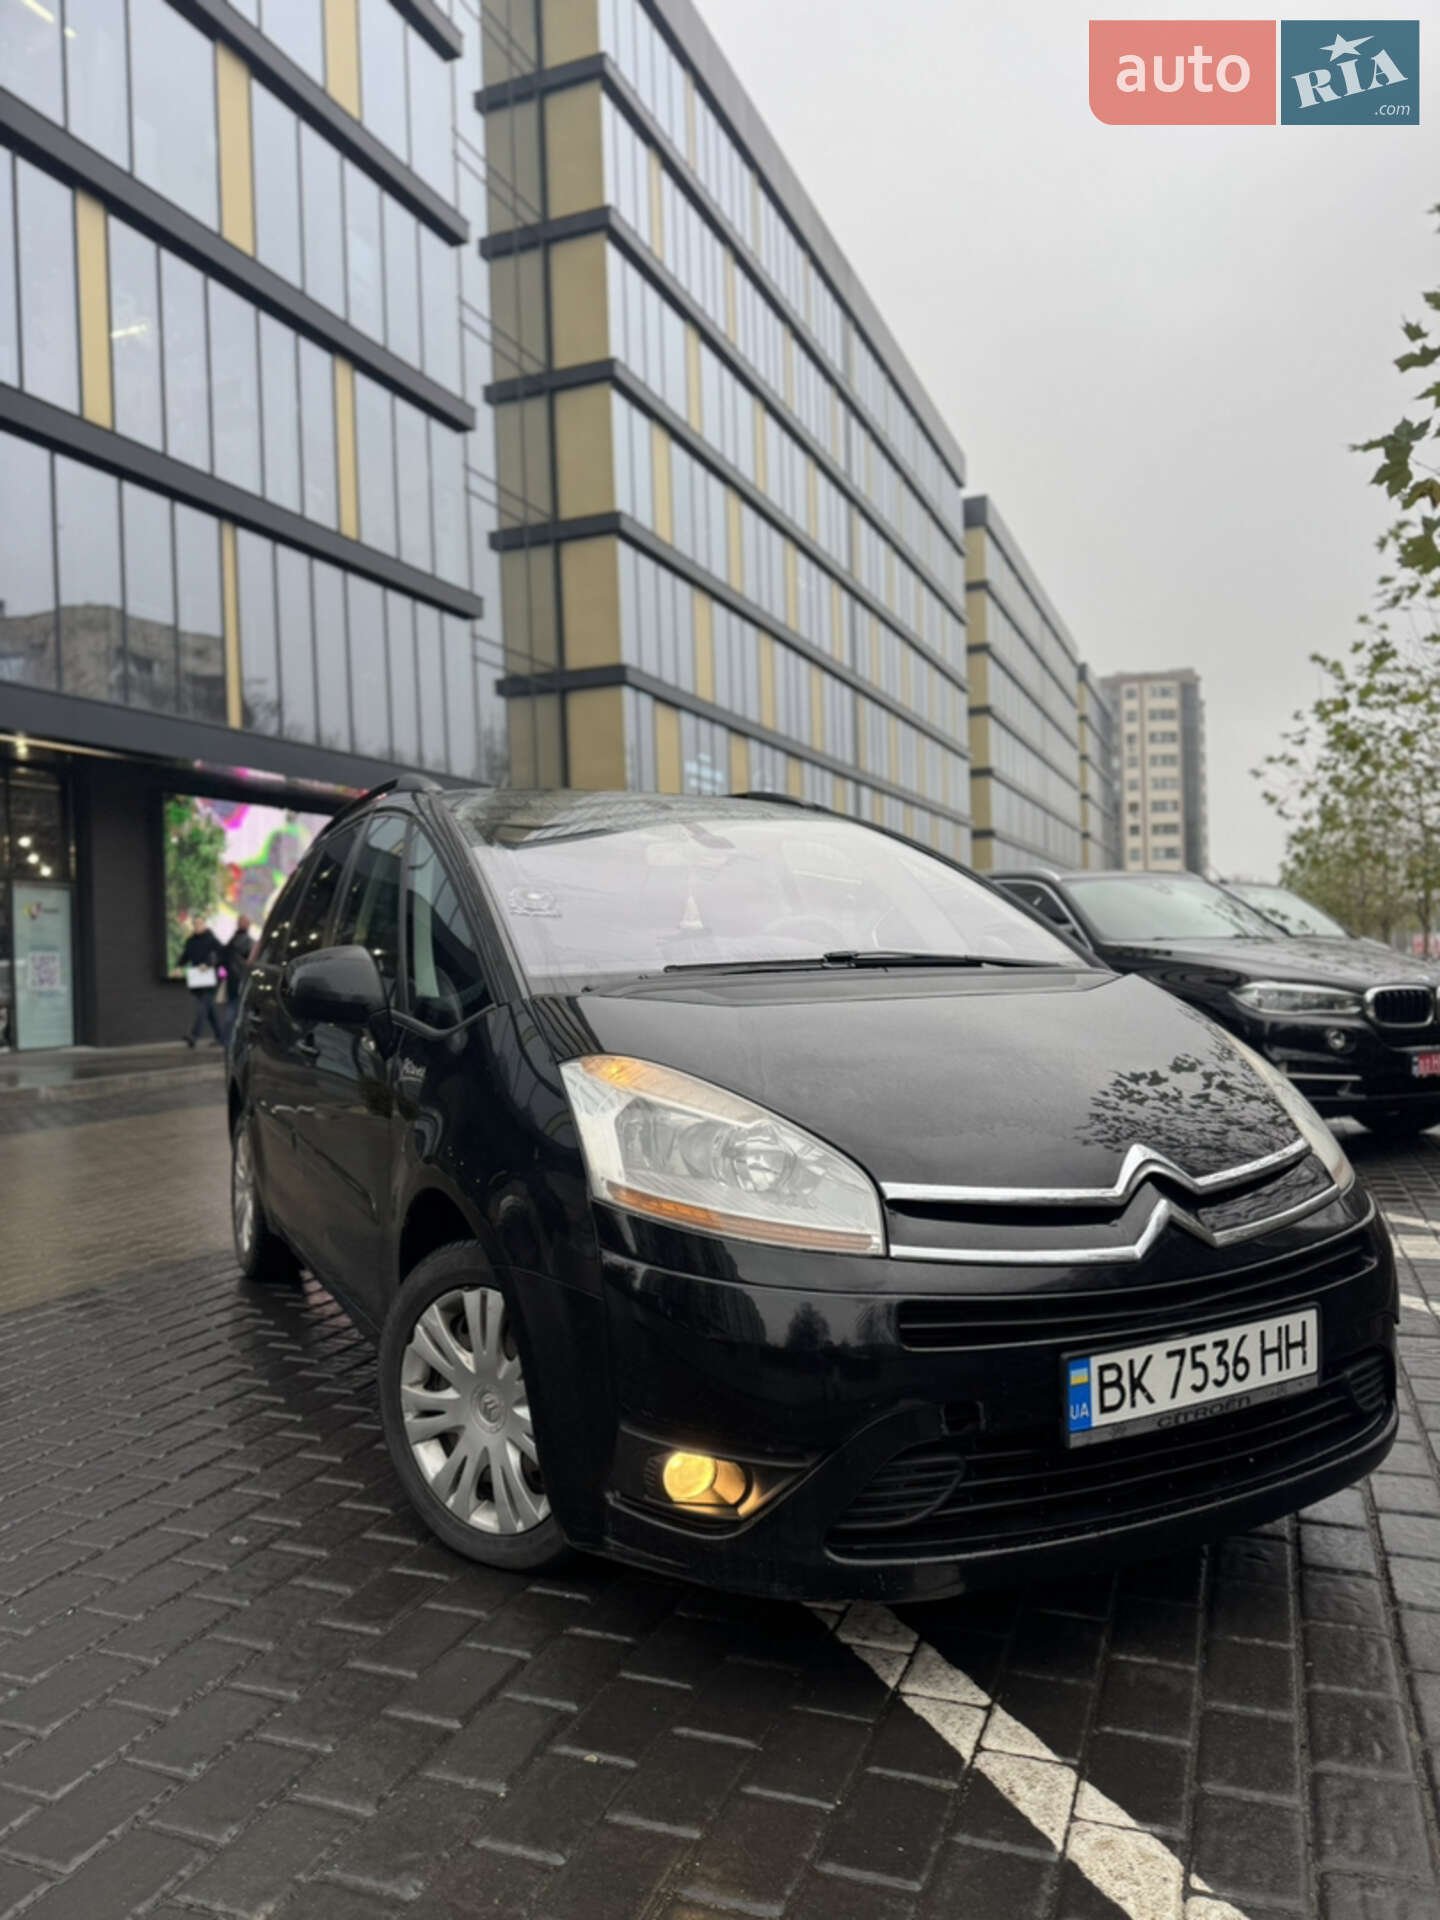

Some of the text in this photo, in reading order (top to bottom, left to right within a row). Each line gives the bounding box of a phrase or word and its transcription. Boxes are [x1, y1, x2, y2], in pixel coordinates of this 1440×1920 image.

[1098, 1320, 1307, 1415] BK 7536 HH
[1069, 1402, 1090, 1420] UA
